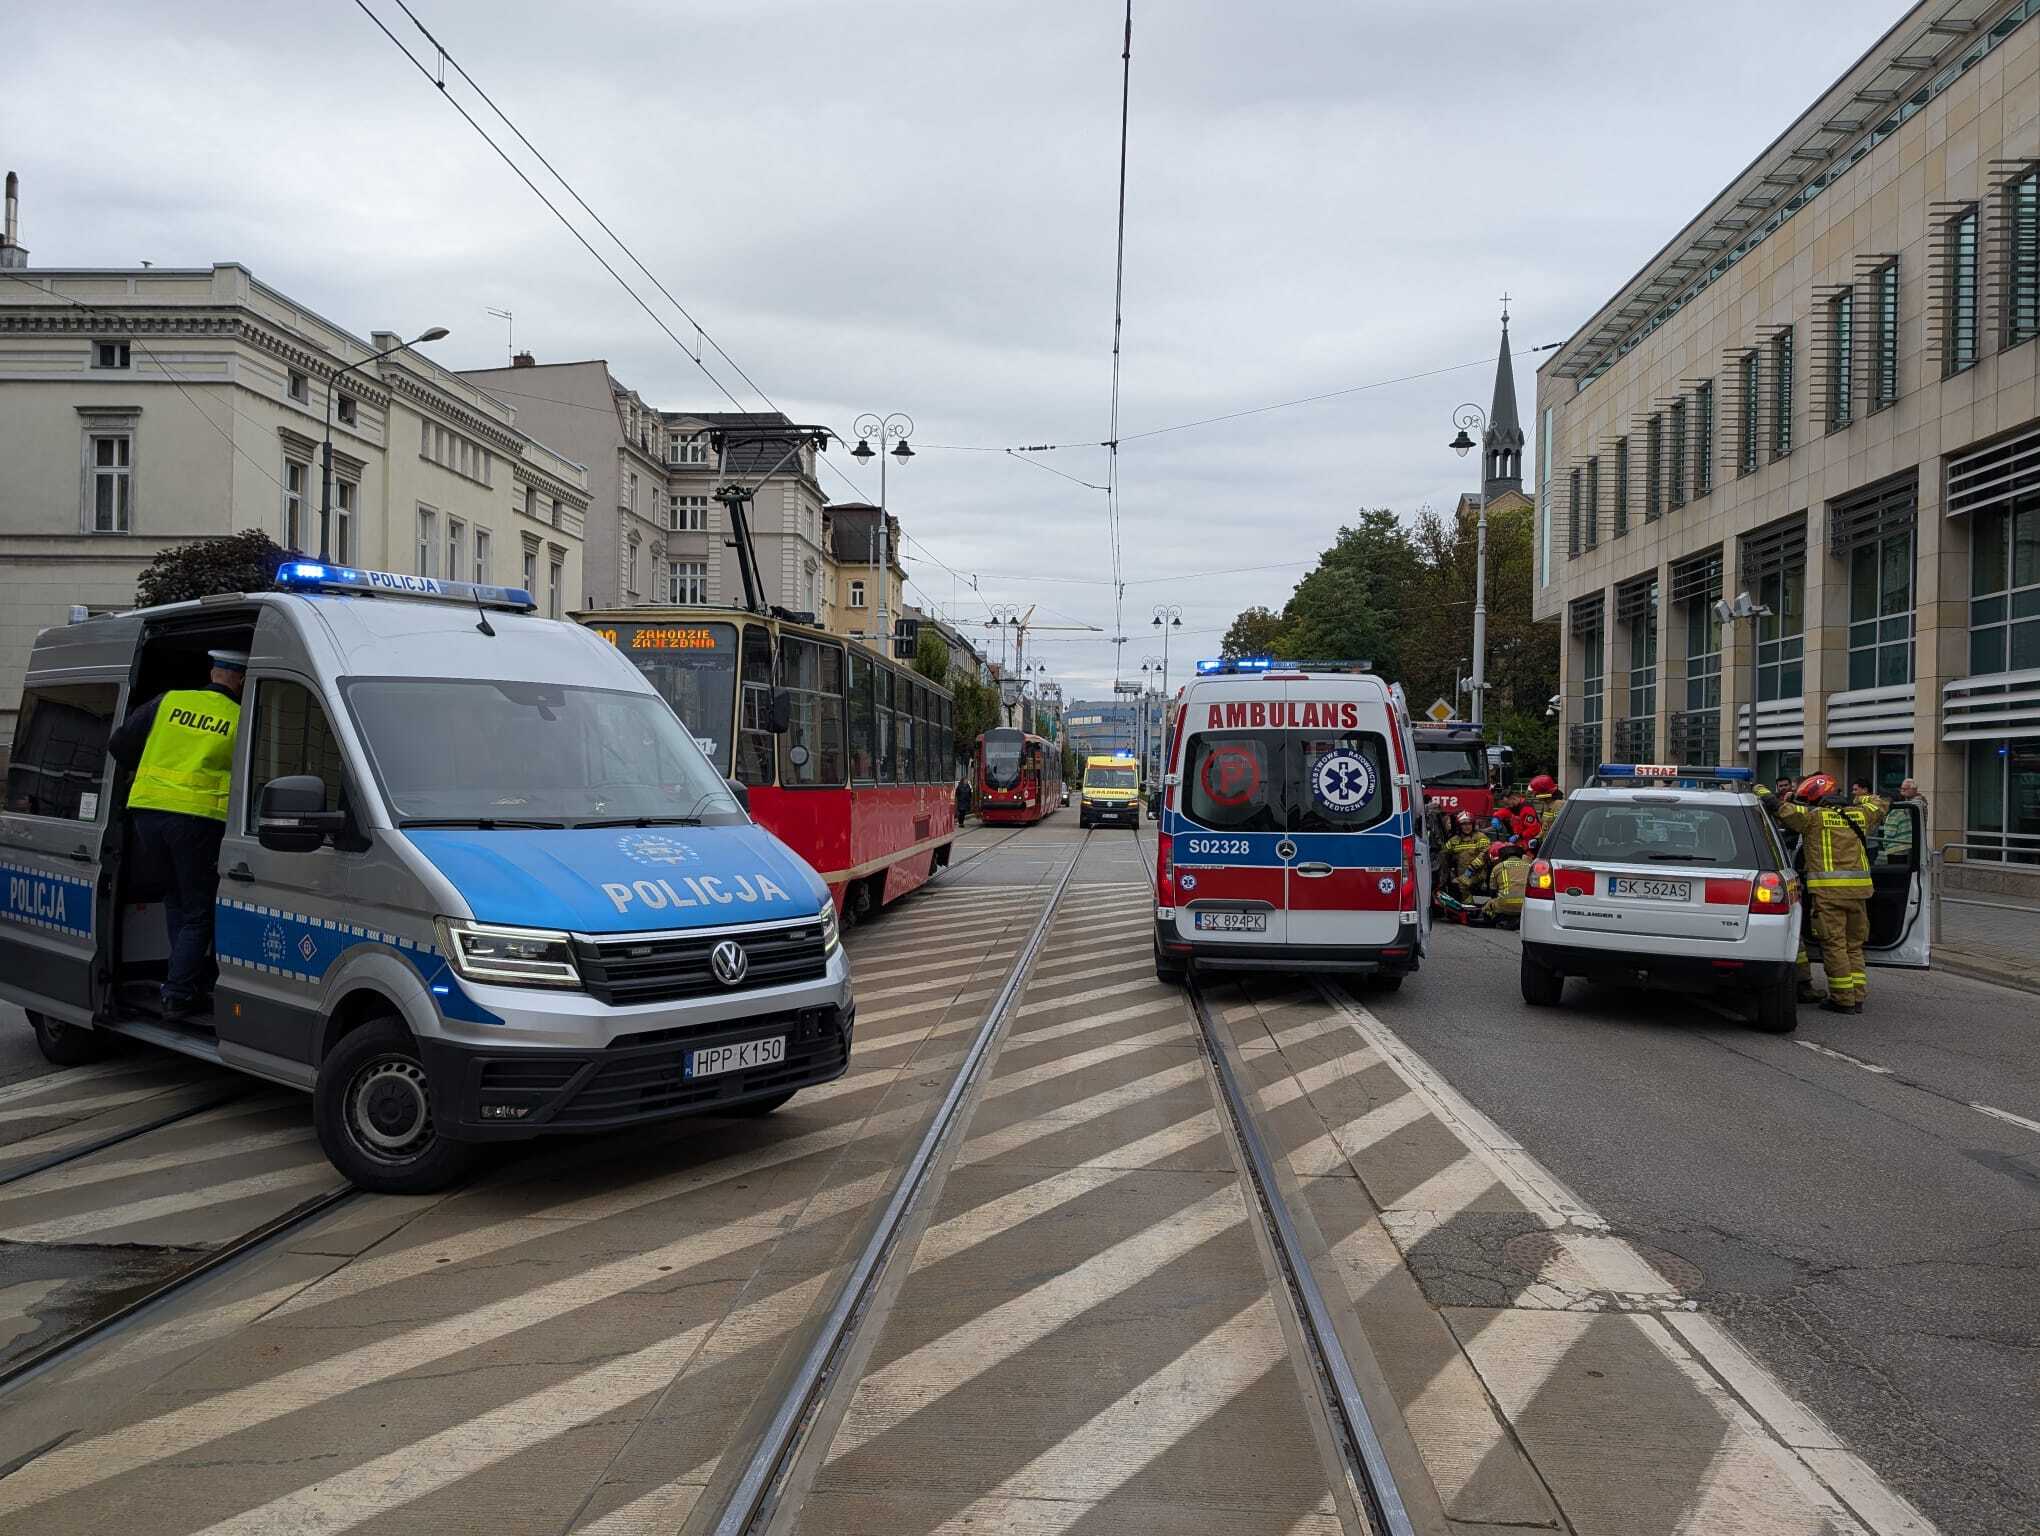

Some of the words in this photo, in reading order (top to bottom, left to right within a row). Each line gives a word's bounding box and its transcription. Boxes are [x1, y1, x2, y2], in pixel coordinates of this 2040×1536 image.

[370, 572, 438, 593] POLICJA
[632, 639, 716, 648] ZAJEZDNIA
[636, 629, 711, 639] ZAWODZIE
[168, 708, 231, 736] POLICJA
[1207, 703, 1358, 729] AMBULANS
[1323, 799, 1366, 812] MEDYCZNE
[1189, 839, 1250, 854] S02328
[601, 873, 790, 913] POLICJA
[1618, 880, 1638, 894] SK
[1643, 881, 1687, 897] 562AS
[10, 876, 66, 922] POLICJA
[1204, 914, 1220, 928] SK
[1224, 914, 1262, 928] 894PK
[697, 1047, 733, 1075] HPP
[739, 1039, 781, 1067] K150
